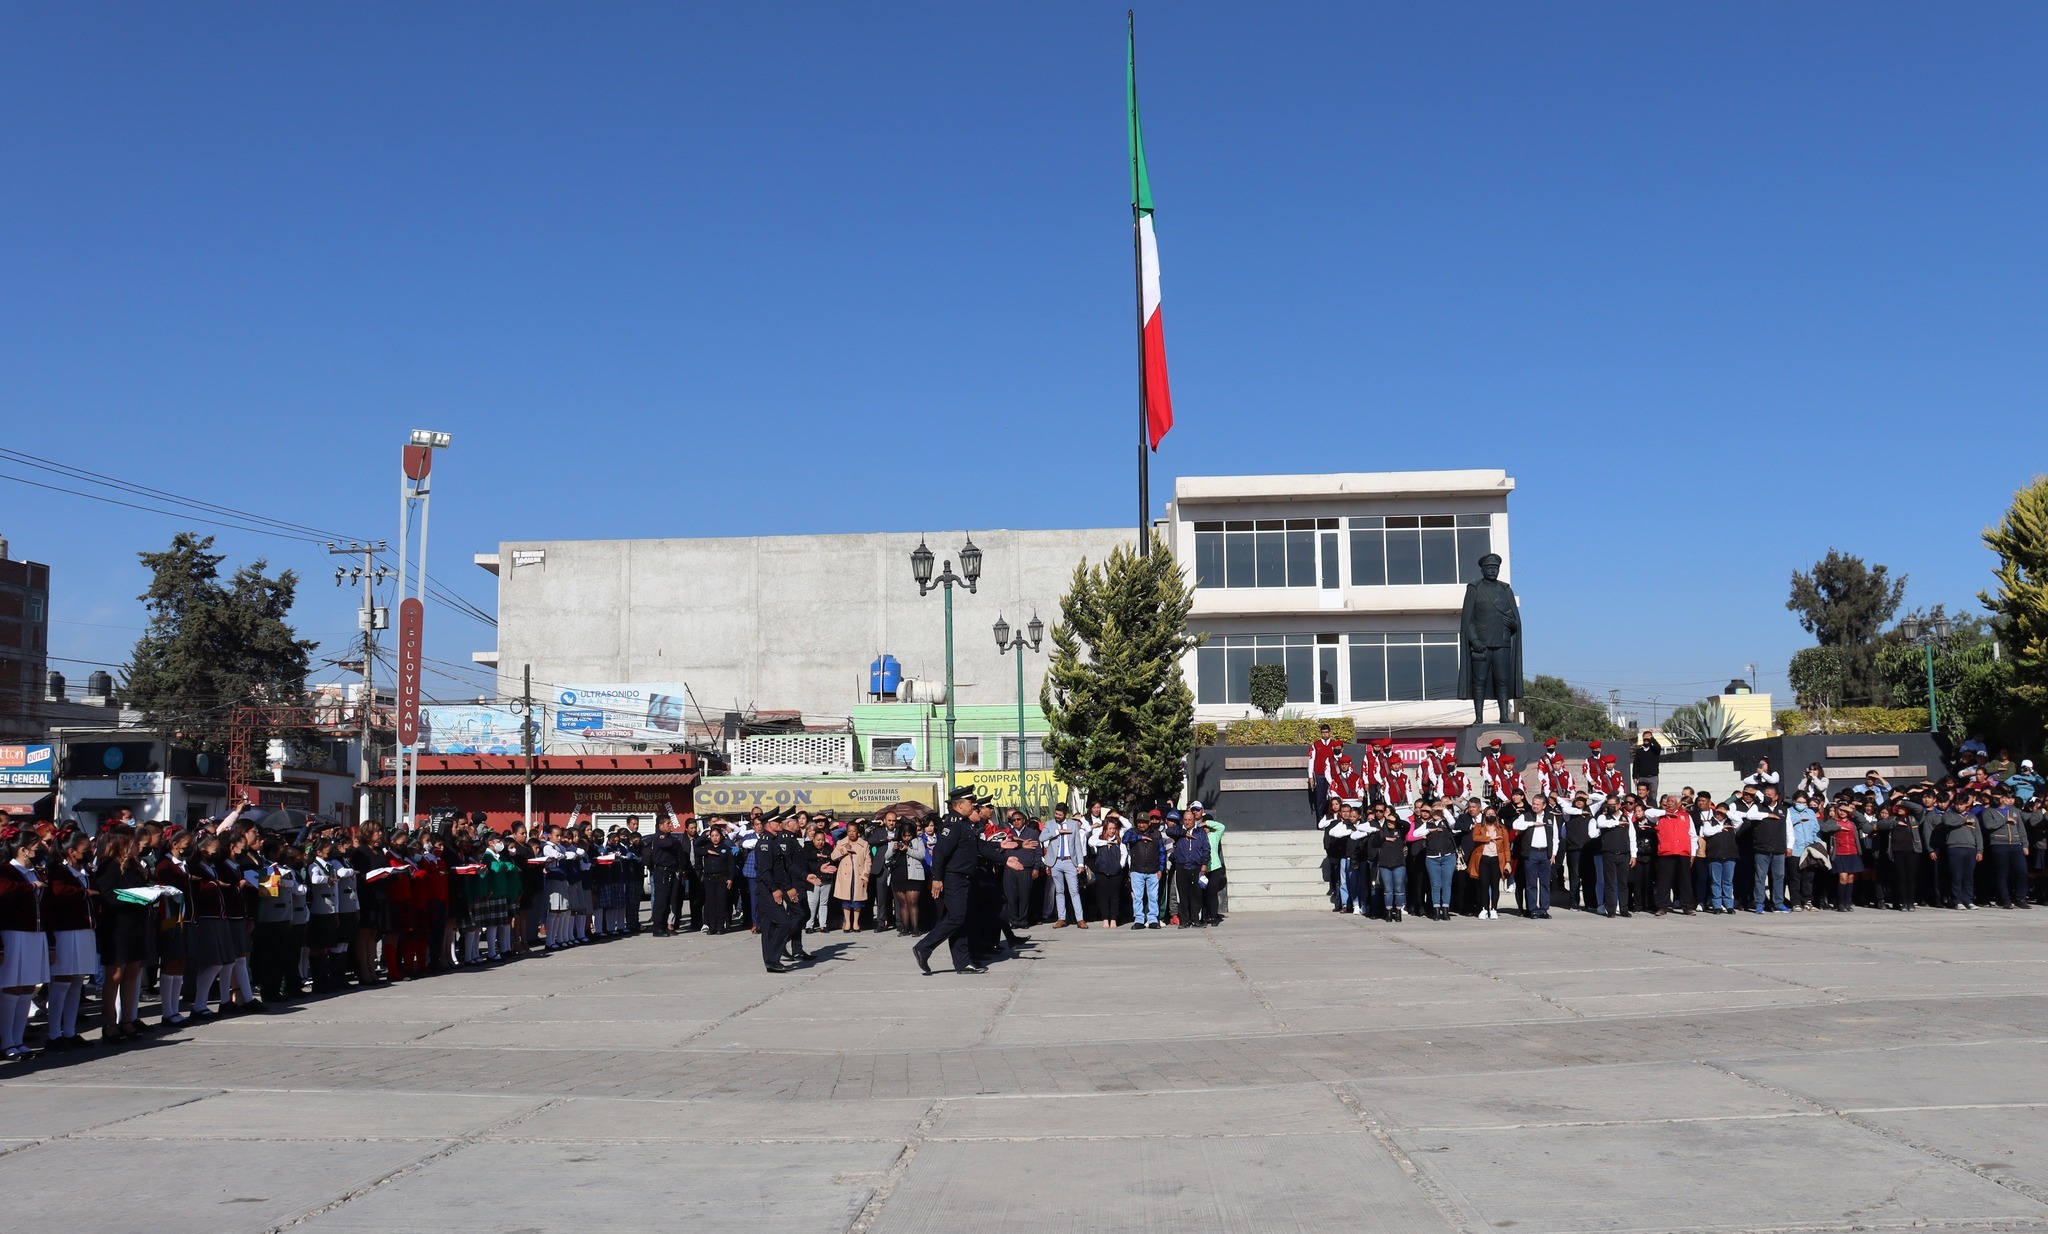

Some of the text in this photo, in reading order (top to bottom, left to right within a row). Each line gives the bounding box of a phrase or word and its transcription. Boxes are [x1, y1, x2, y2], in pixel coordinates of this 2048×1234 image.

[580, 690, 640, 698] ULTRASONIDO
[28, 749, 50, 762] OUTLET
[12, 773, 50, 784] GENERAL
[574, 792, 613, 801] TORTERIA
[634, 791, 671, 800] TAQUERIA
[694, 789, 812, 805] COPY-ON
